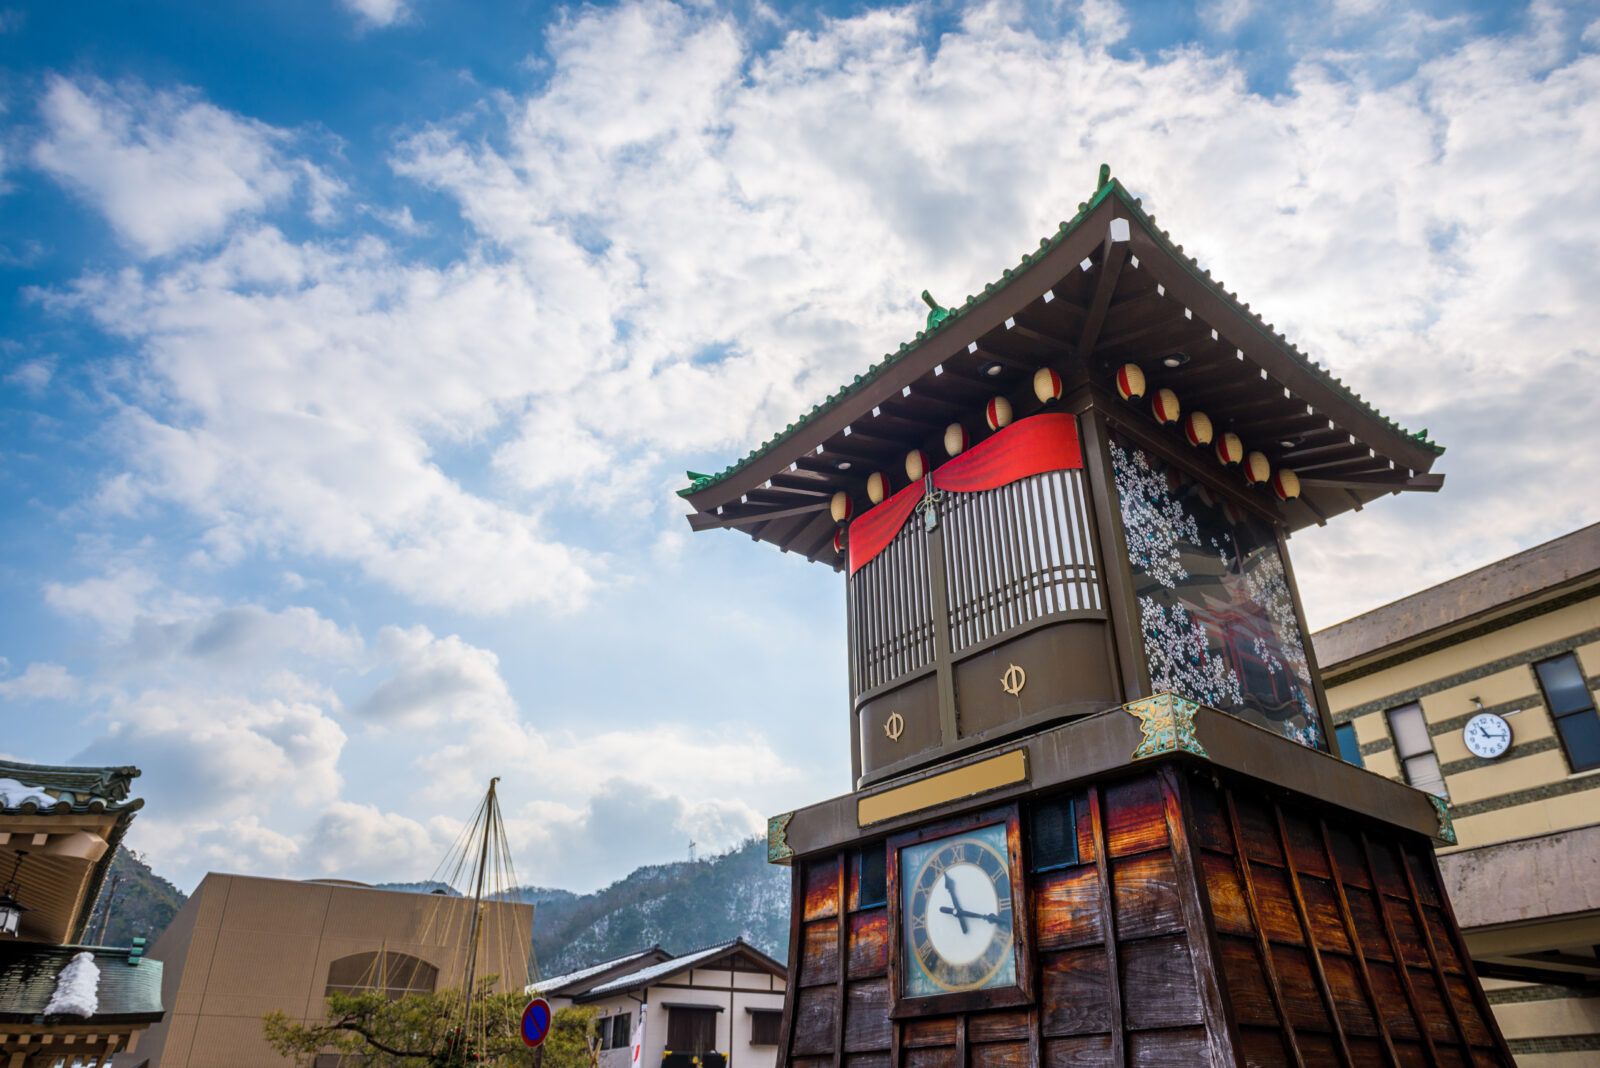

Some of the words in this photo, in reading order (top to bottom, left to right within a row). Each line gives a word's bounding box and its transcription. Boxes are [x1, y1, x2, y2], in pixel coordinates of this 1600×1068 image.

[952, 845, 965, 864] XII
[976, 849, 985, 865] I
[930, 856, 945, 877] XI
[990, 866, 1004, 882] II
[917, 883, 931, 898] X
[1000, 898, 1012, 911] III
[912, 915, 927, 930] IX
